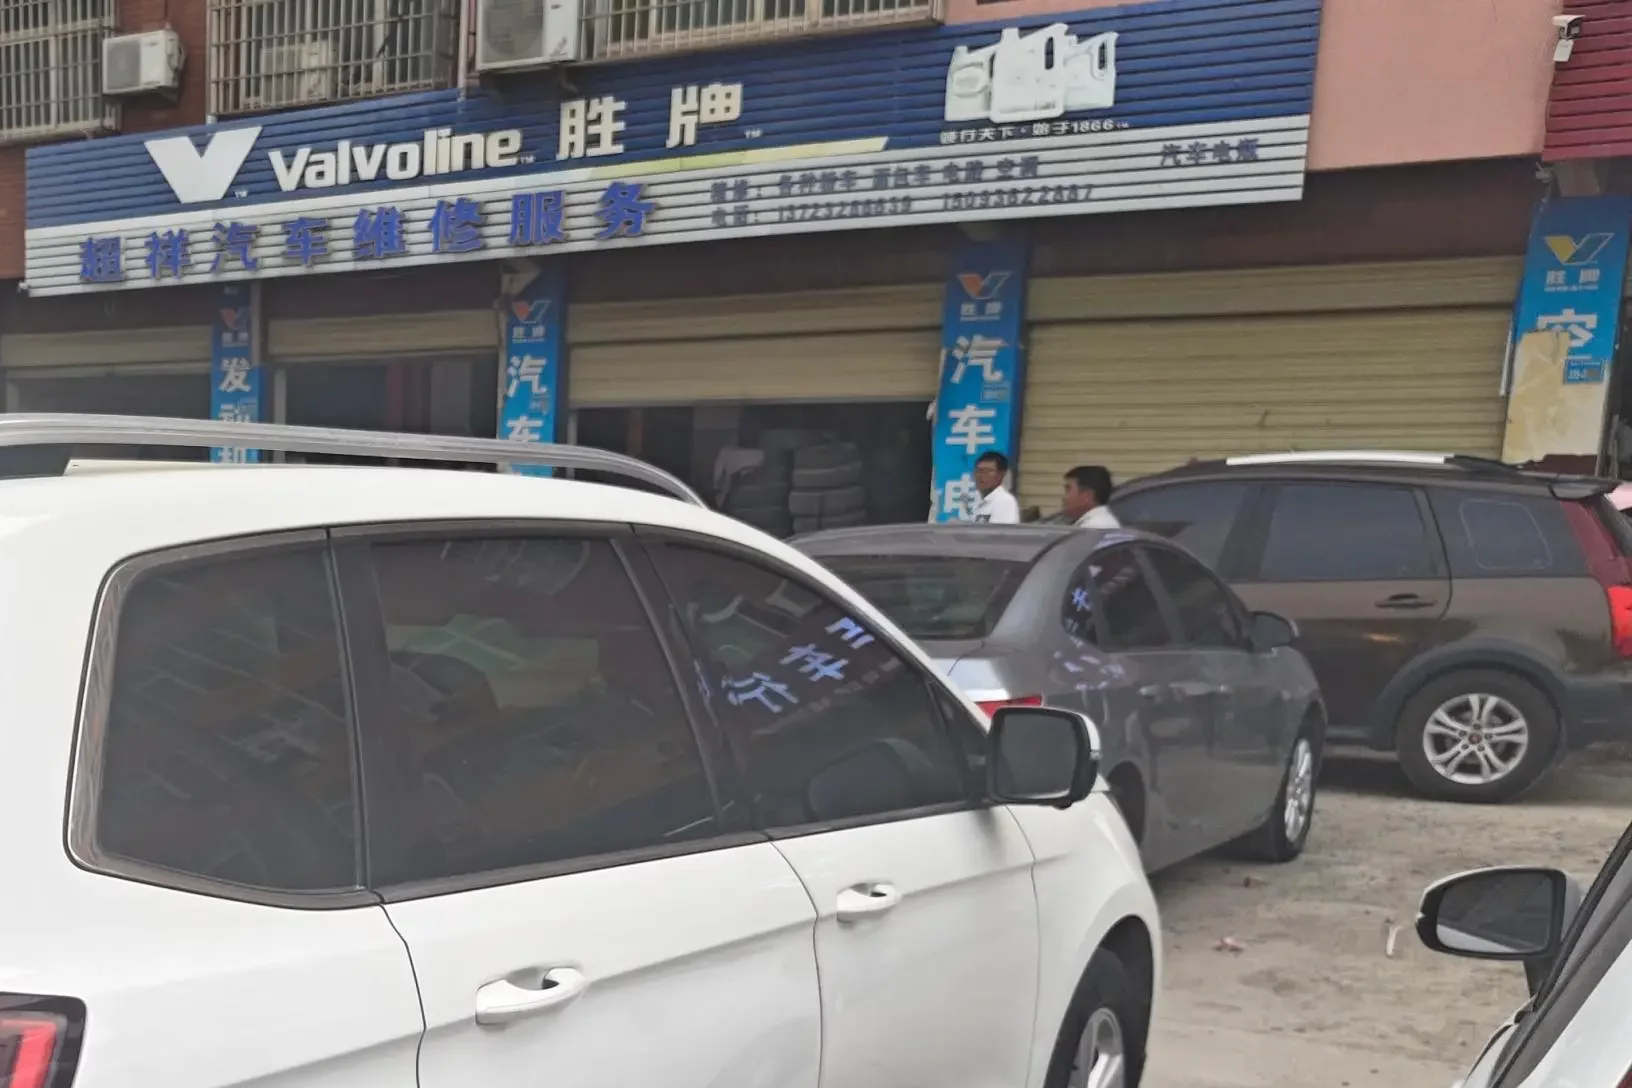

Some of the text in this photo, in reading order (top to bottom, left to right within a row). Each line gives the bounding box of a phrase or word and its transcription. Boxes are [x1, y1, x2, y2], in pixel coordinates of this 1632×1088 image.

[269, 128, 522, 193] Valvoline
[555, 82, 743, 161] 胜牌
[78, 181, 659, 285] 超祥汽车维修服务
